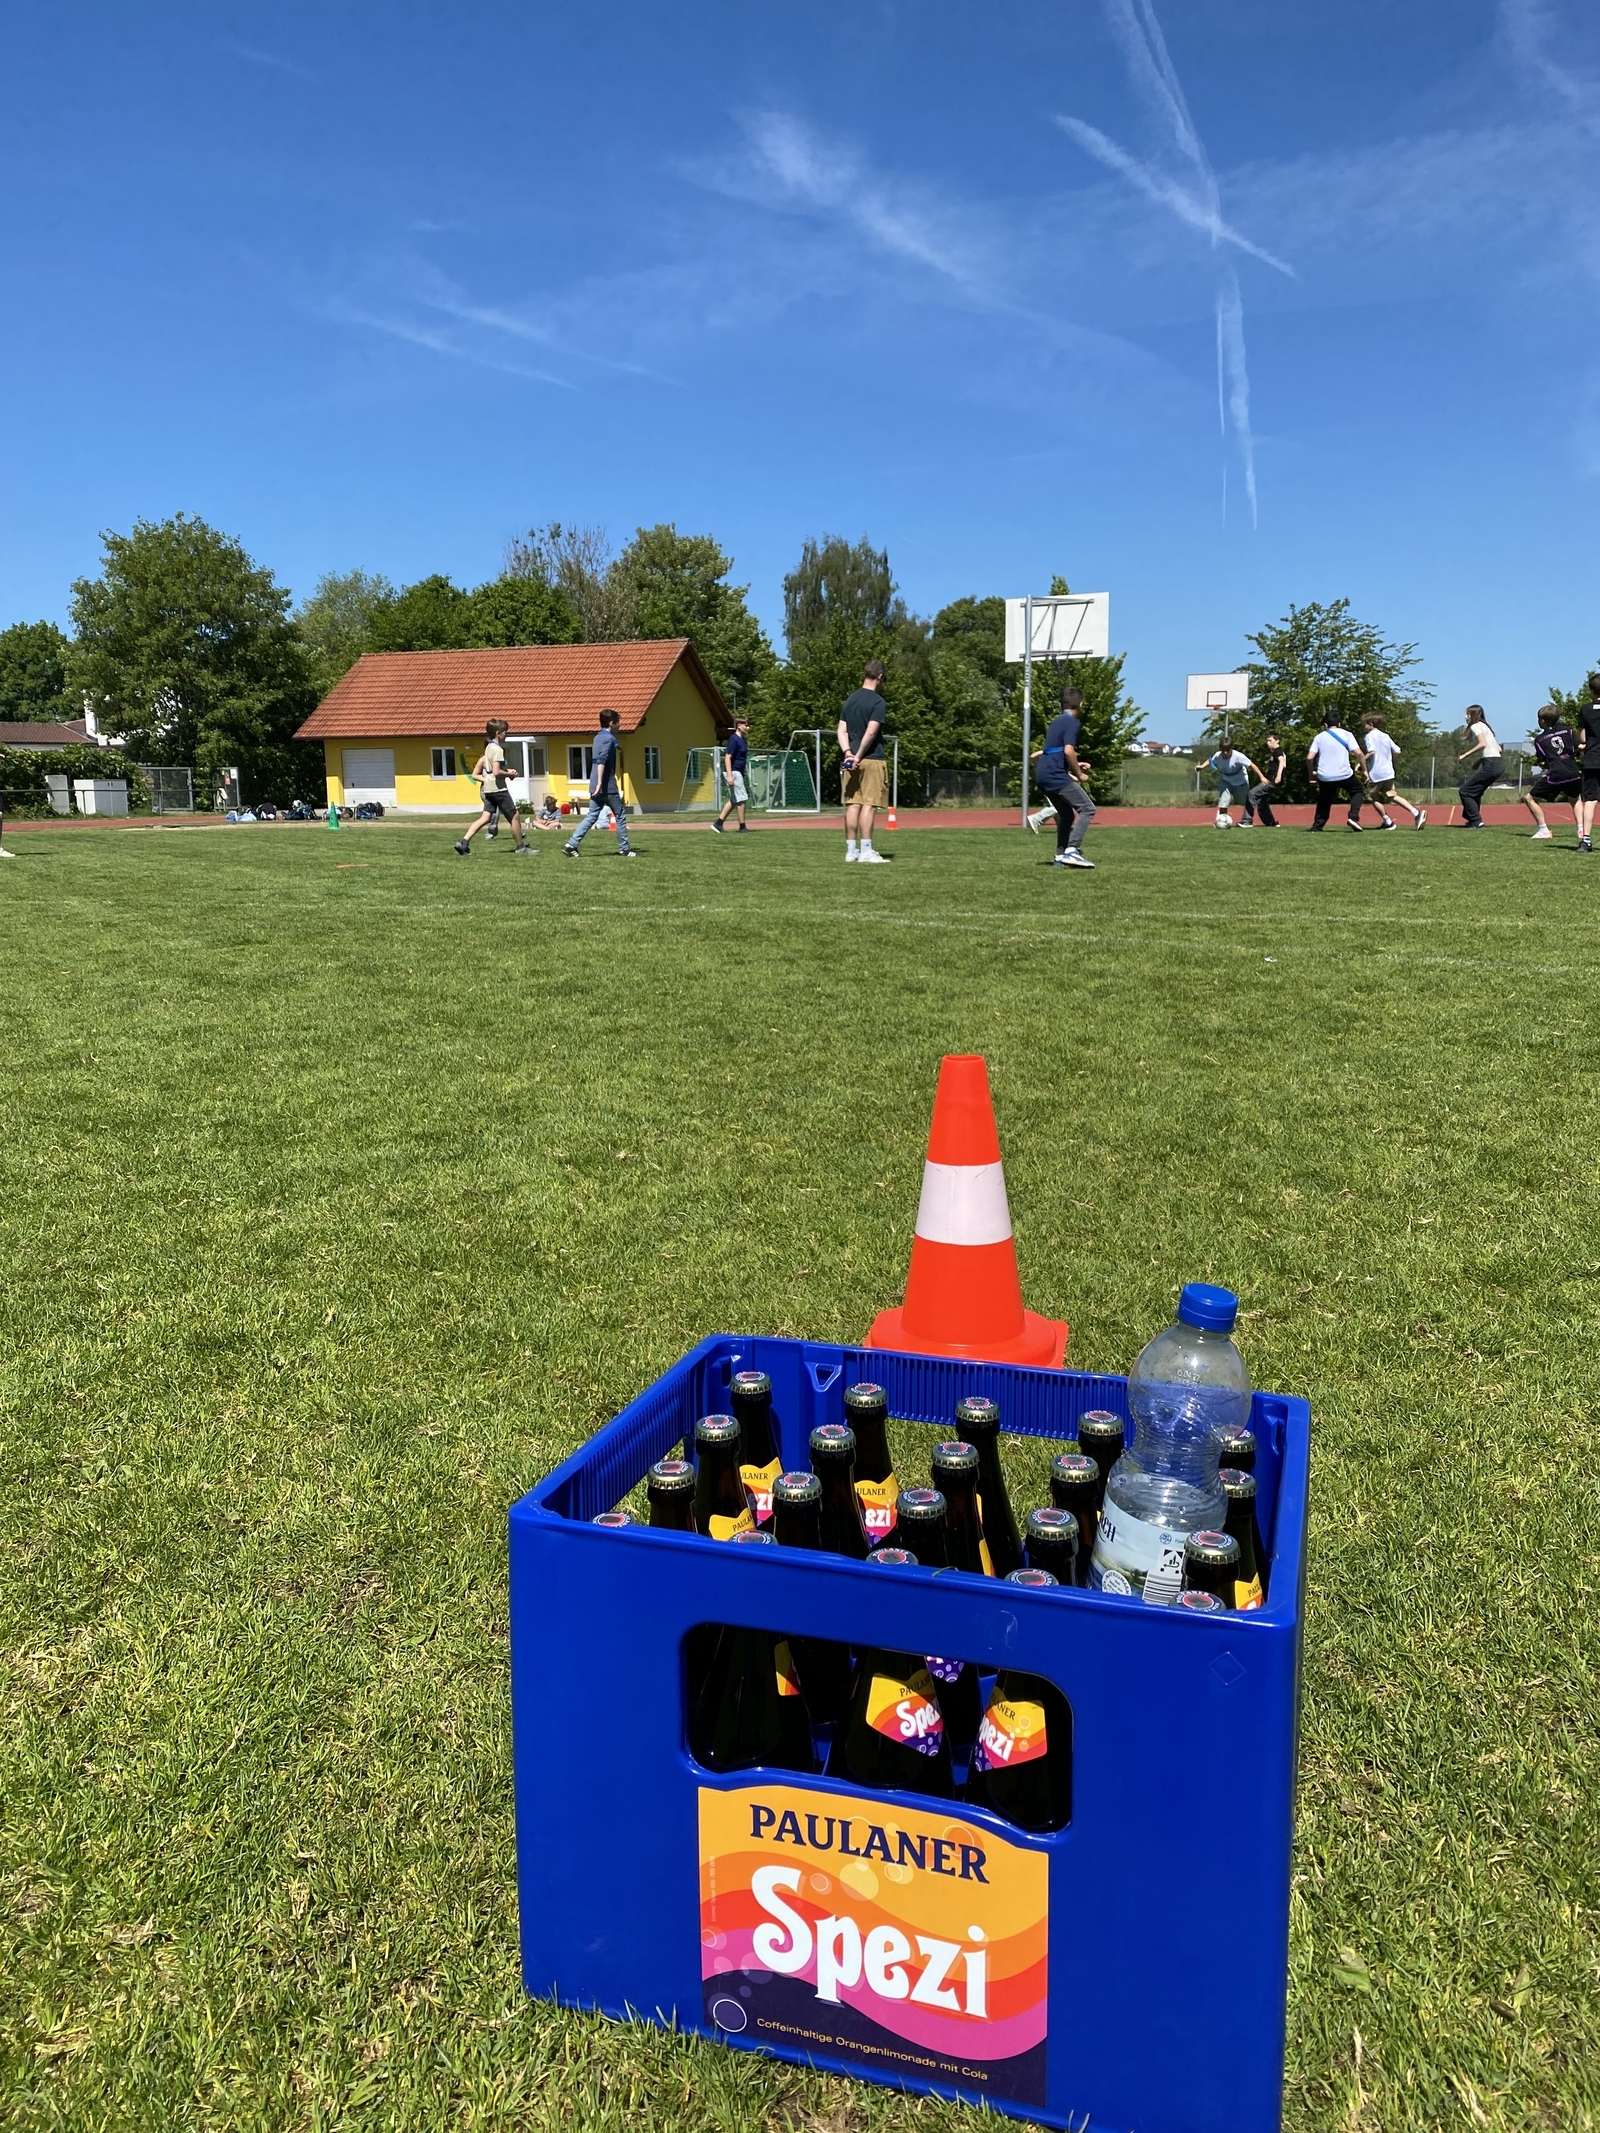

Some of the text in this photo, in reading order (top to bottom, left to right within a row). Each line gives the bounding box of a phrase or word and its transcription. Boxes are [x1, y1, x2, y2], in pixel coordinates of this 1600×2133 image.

[1551, 736, 1565, 755] 9
[749, 1804, 990, 1884] PAULANER
[750, 1864, 988, 2020] Spezi
[756, 2017, 988, 2081] Coffeinhaltige Orangenlimonade mit Cola
